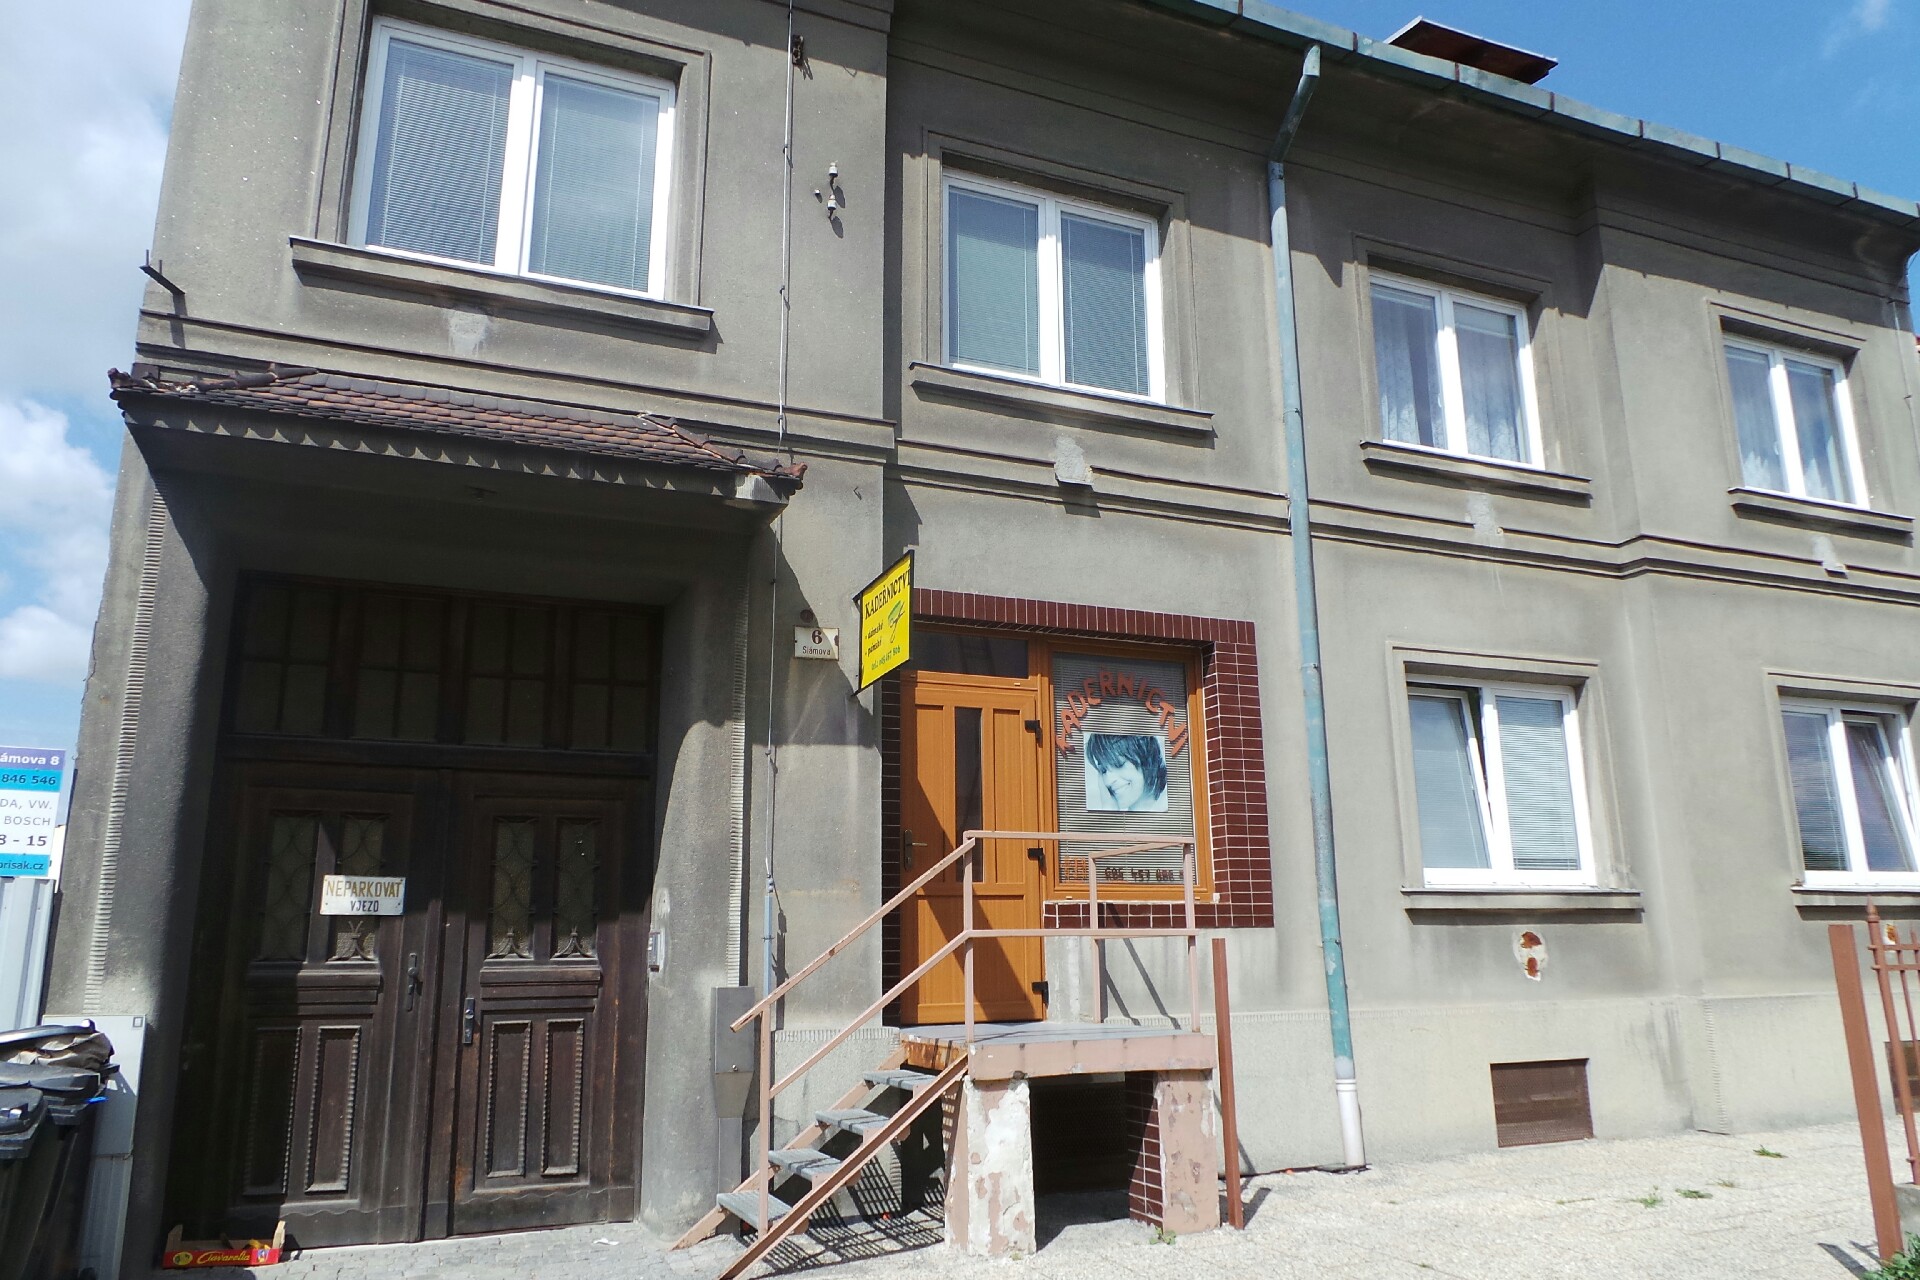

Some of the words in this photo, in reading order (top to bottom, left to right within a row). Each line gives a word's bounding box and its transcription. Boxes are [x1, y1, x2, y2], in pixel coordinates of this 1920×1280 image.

[812, 629, 823, 645] 6
[50, 756, 60, 766] 8
[2, 774, 27, 784] 846
[31, 776, 56, 785] 546
[29, 800, 52, 810] VW.
[4, 816, 51, 826] BOSCH
[27, 835, 47, 847] 15
[326, 880, 402, 897] NEPARKOVAT
